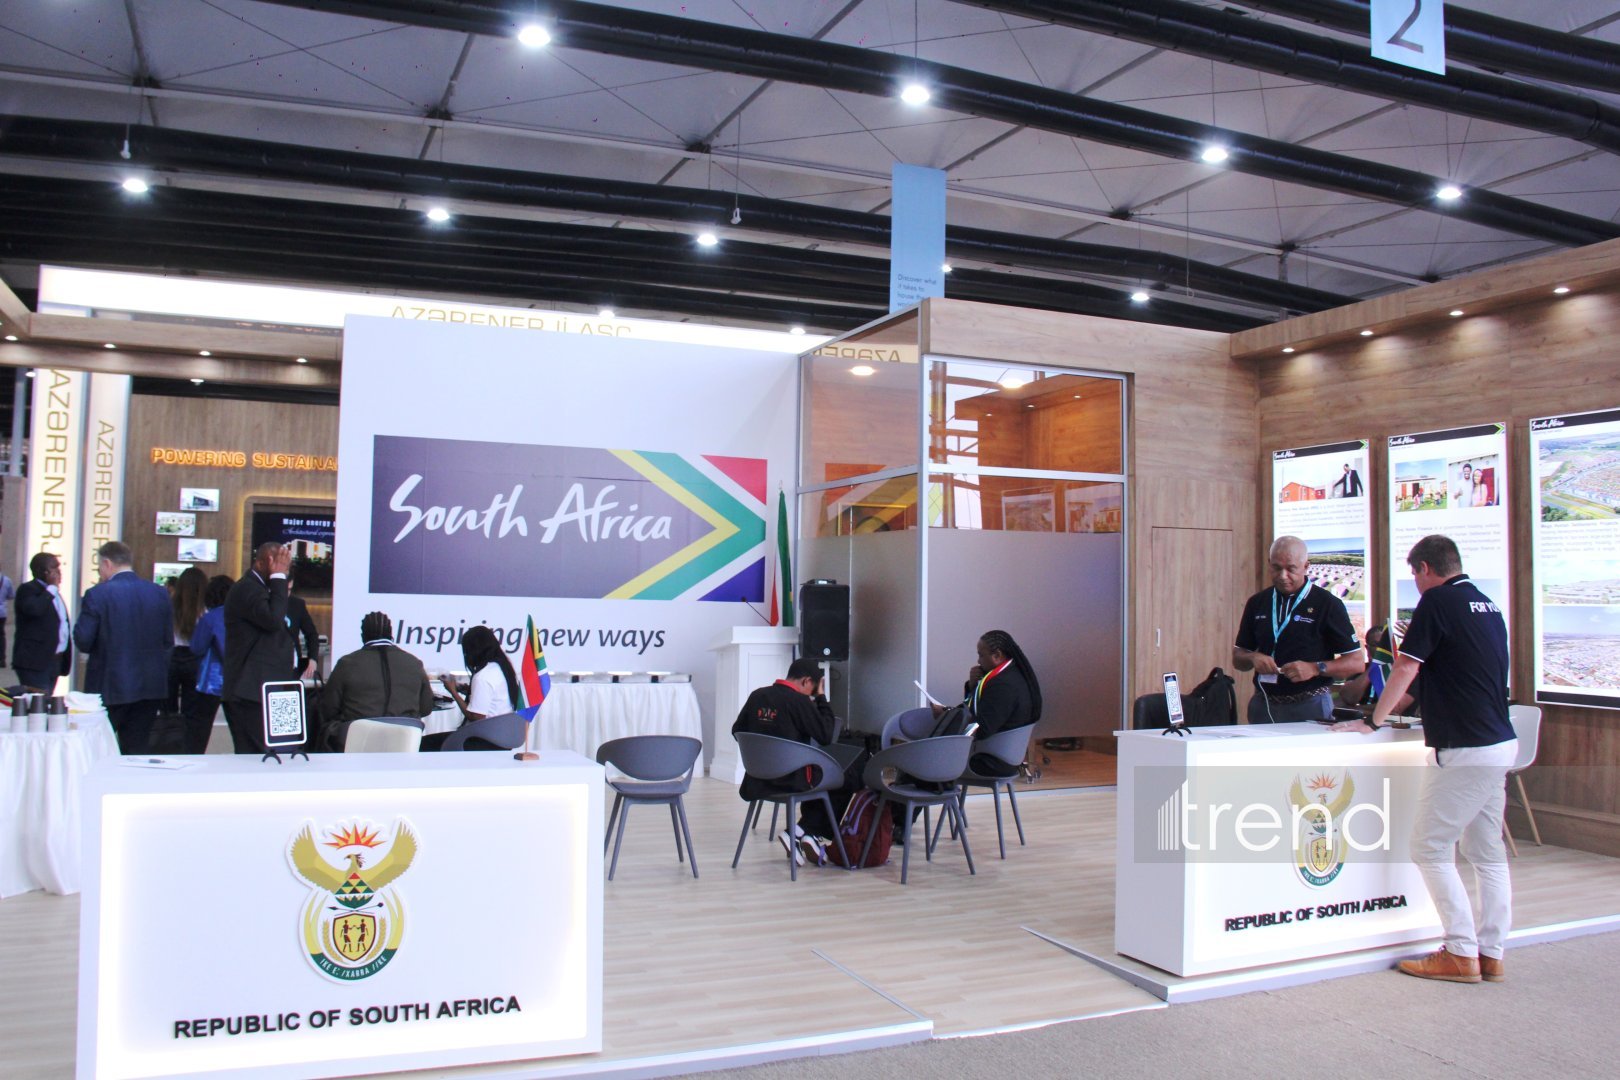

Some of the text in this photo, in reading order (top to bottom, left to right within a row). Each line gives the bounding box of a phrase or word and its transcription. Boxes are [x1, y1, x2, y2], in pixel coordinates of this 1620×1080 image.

[1387, 0, 1424, 54] 2
[151, 447, 247, 468] POWERING
[389, 473, 672, 544] South Africa
[1469, 601, 1487, 613] FOR
[536, 628, 591, 647] new
[598, 629, 666, 655] ways
[1224, 894, 1407, 932] REPUBLIC OF SOUTH AFRICA
[174, 995, 522, 1039] REPUBLIC OF SOUTH AFRICA
